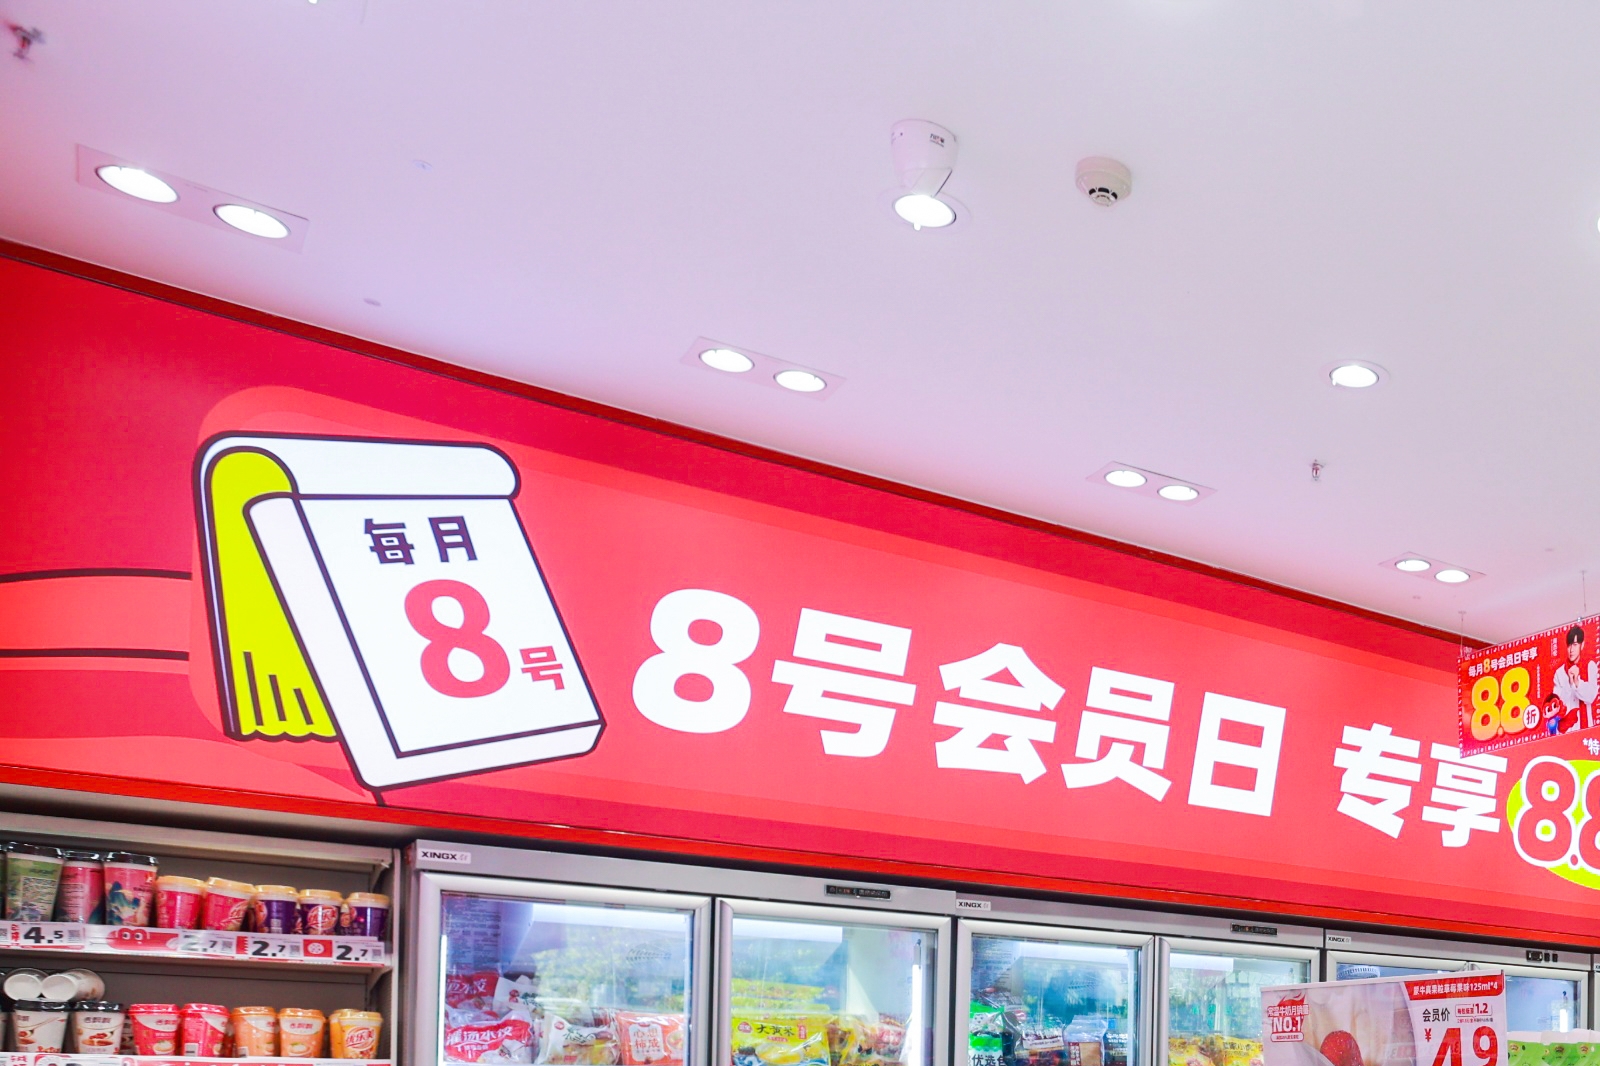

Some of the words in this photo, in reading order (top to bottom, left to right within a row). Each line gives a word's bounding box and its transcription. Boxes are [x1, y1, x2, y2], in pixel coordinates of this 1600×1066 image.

[364, 515, 478, 565] 每月
[403, 578, 565, 699] 8号
[1468, 646, 1539, 678] 每月8号会员日专享
[631, 587, 1288, 817] 8号会员日
[1471, 666, 1541, 742] 8.8折
[24, 926, 64, 944] 4.5
[252, 940, 286, 957] 2.7
[336, 944, 370, 961] 2.7
[1271, 1016, 1303, 1033] NO.1
[1422, 1008, 1450, 1023] 会员价
[757, 1024, 794, 1037] 大黄米
